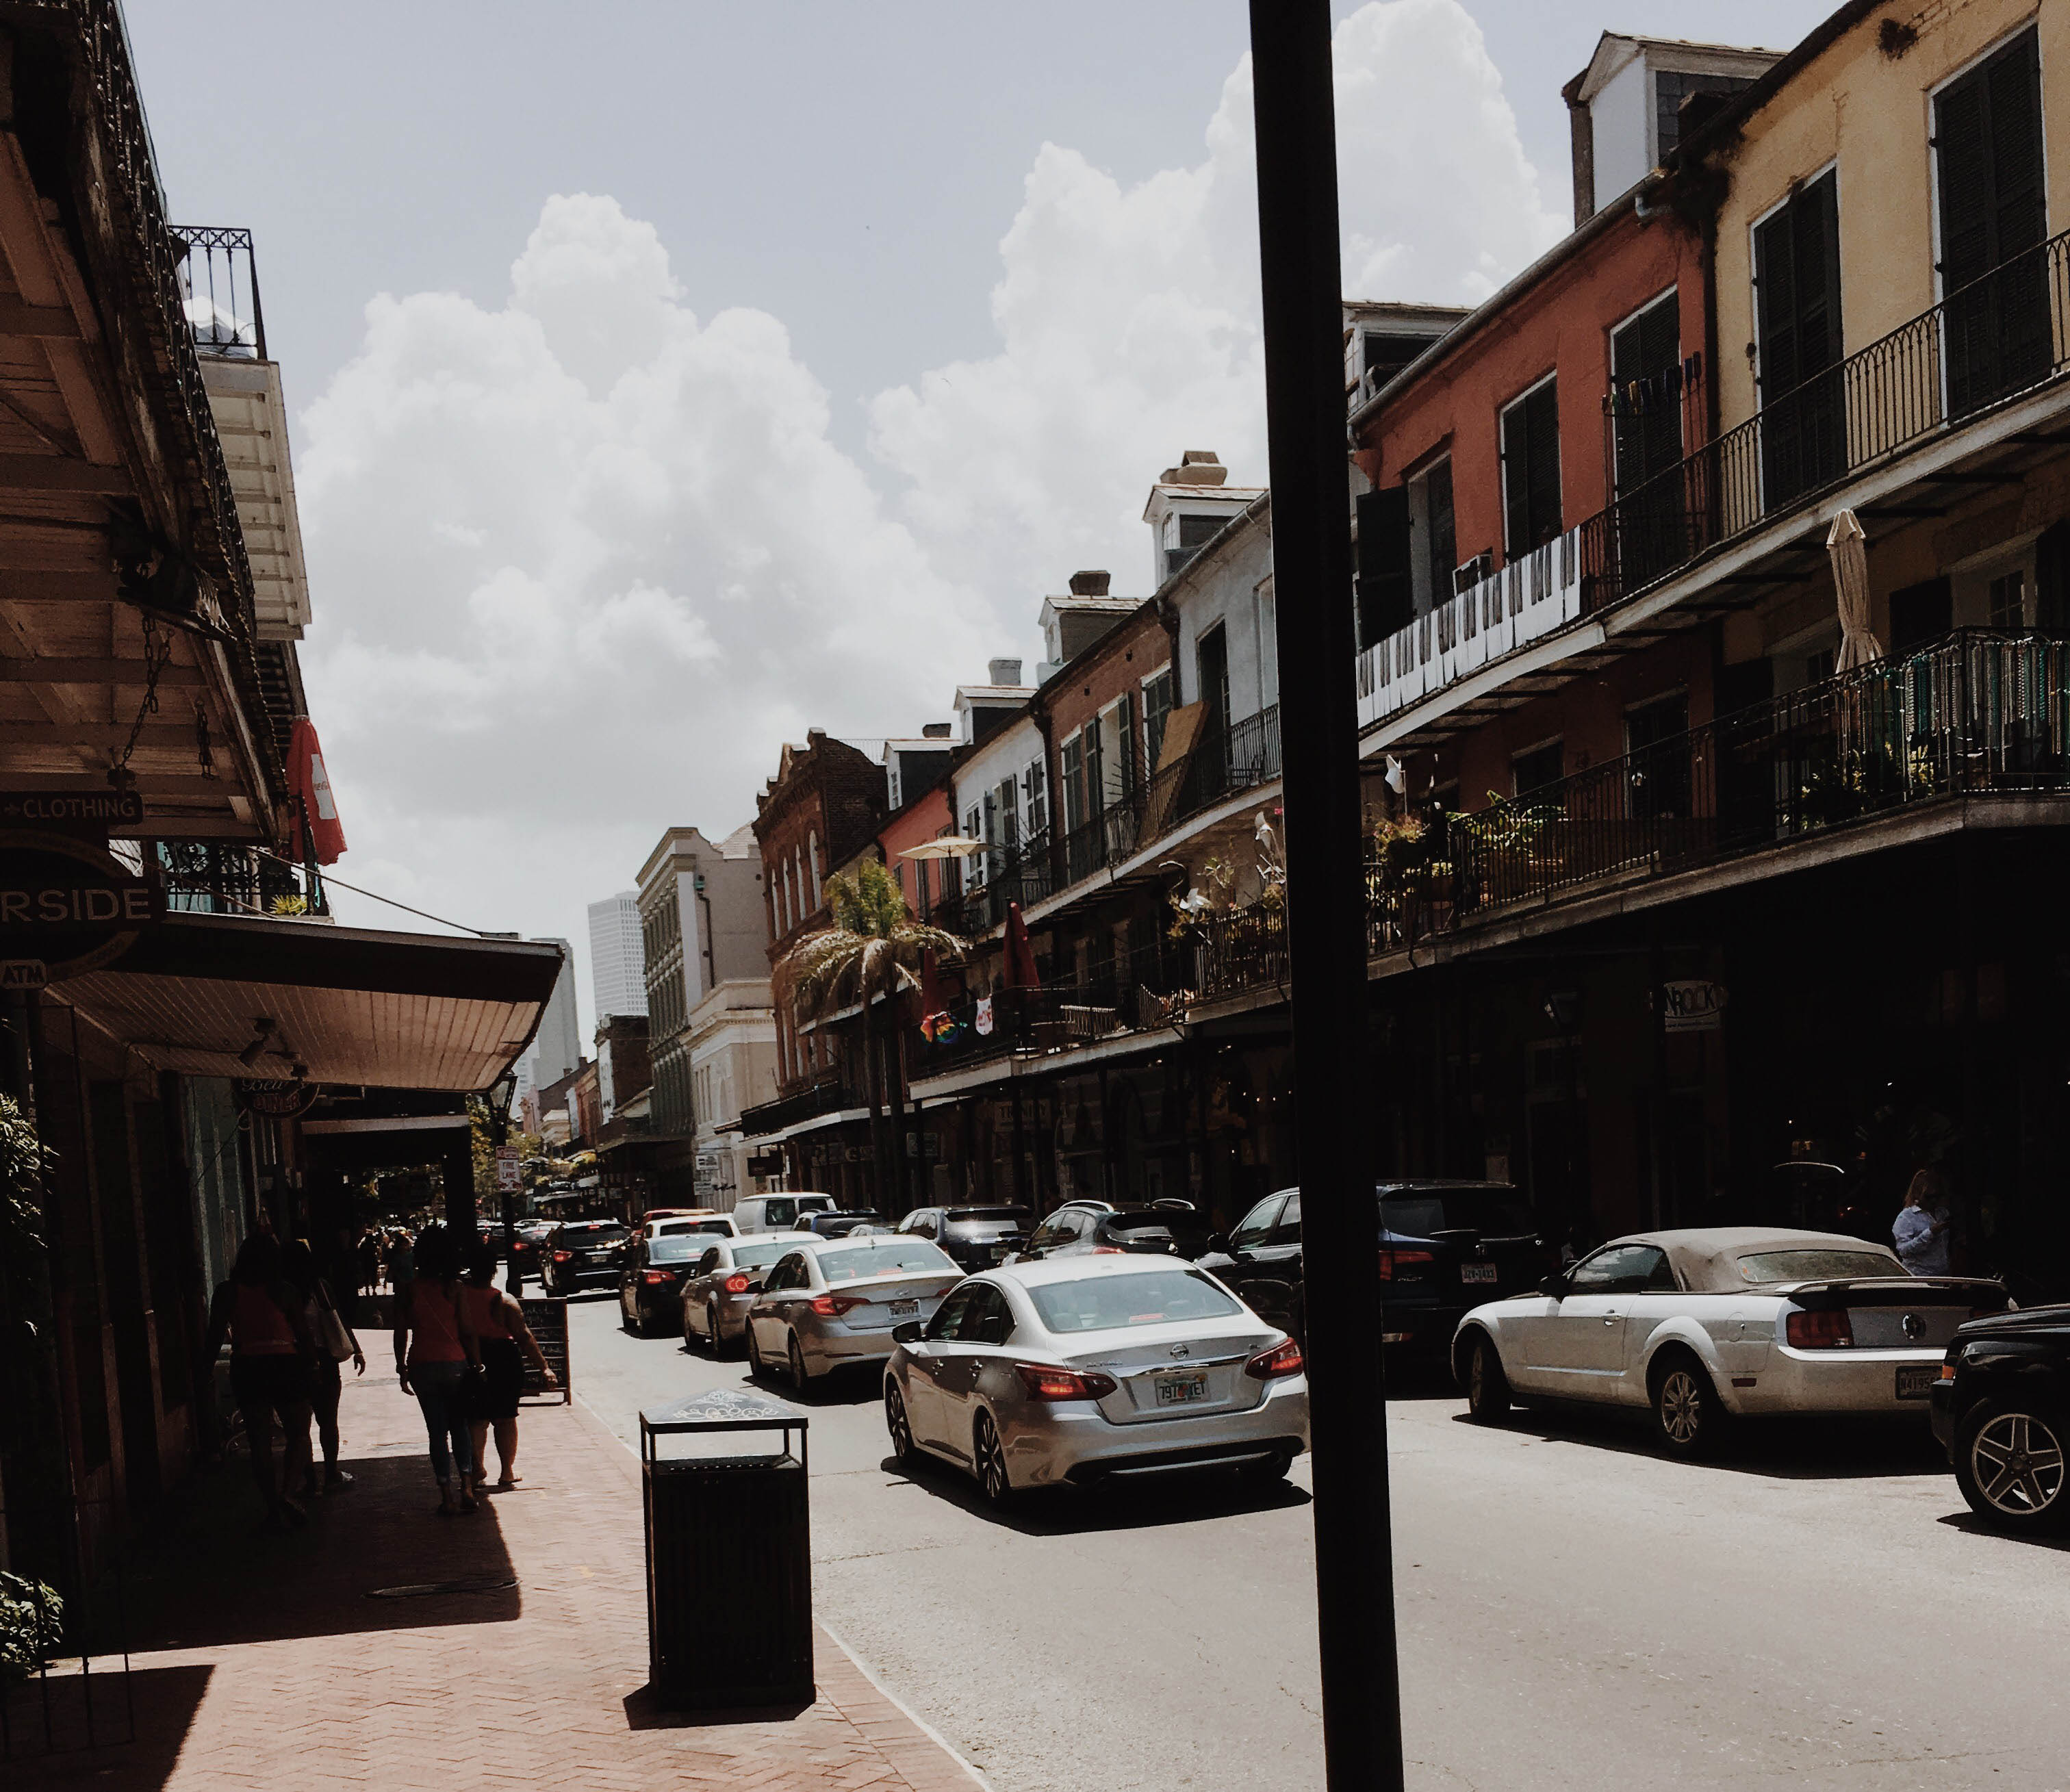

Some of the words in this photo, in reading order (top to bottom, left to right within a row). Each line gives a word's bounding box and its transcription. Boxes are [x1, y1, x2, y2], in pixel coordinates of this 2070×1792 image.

[23, 797, 135, 819] CLOTHING
[1, 888, 152, 922] RSIDE
[3, 964, 45, 985] ATM
